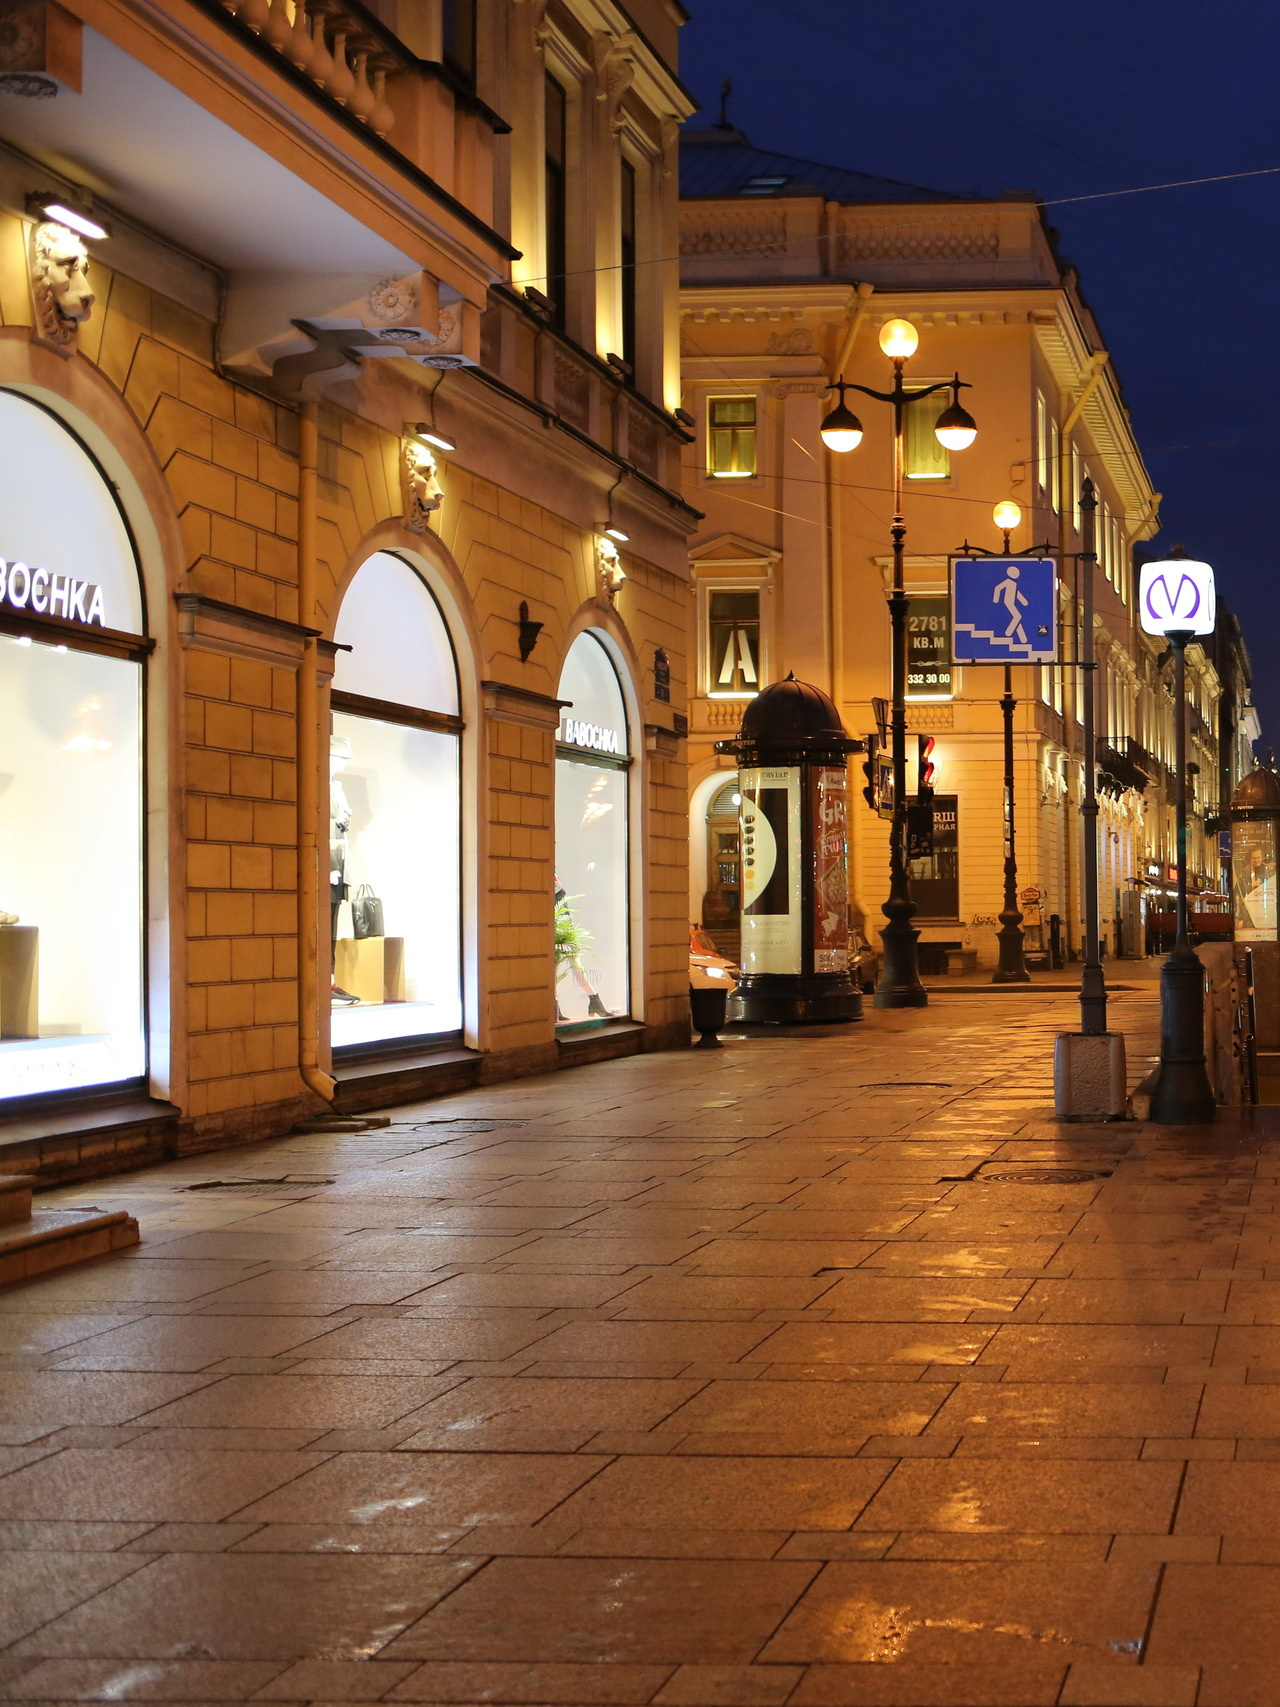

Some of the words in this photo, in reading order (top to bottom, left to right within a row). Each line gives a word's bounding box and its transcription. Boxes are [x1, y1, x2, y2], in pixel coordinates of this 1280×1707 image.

[909, 616, 947, 632] 2781
[913, 636, 945, 649] КВ.М
[908, 673, 924, 684] 332
[925, 673, 938, 684] 30
[939, 673, 951, 684] 00
[564, 718, 619, 754] BABOCHKA
[934, 823, 956, 831] РНАЯ
